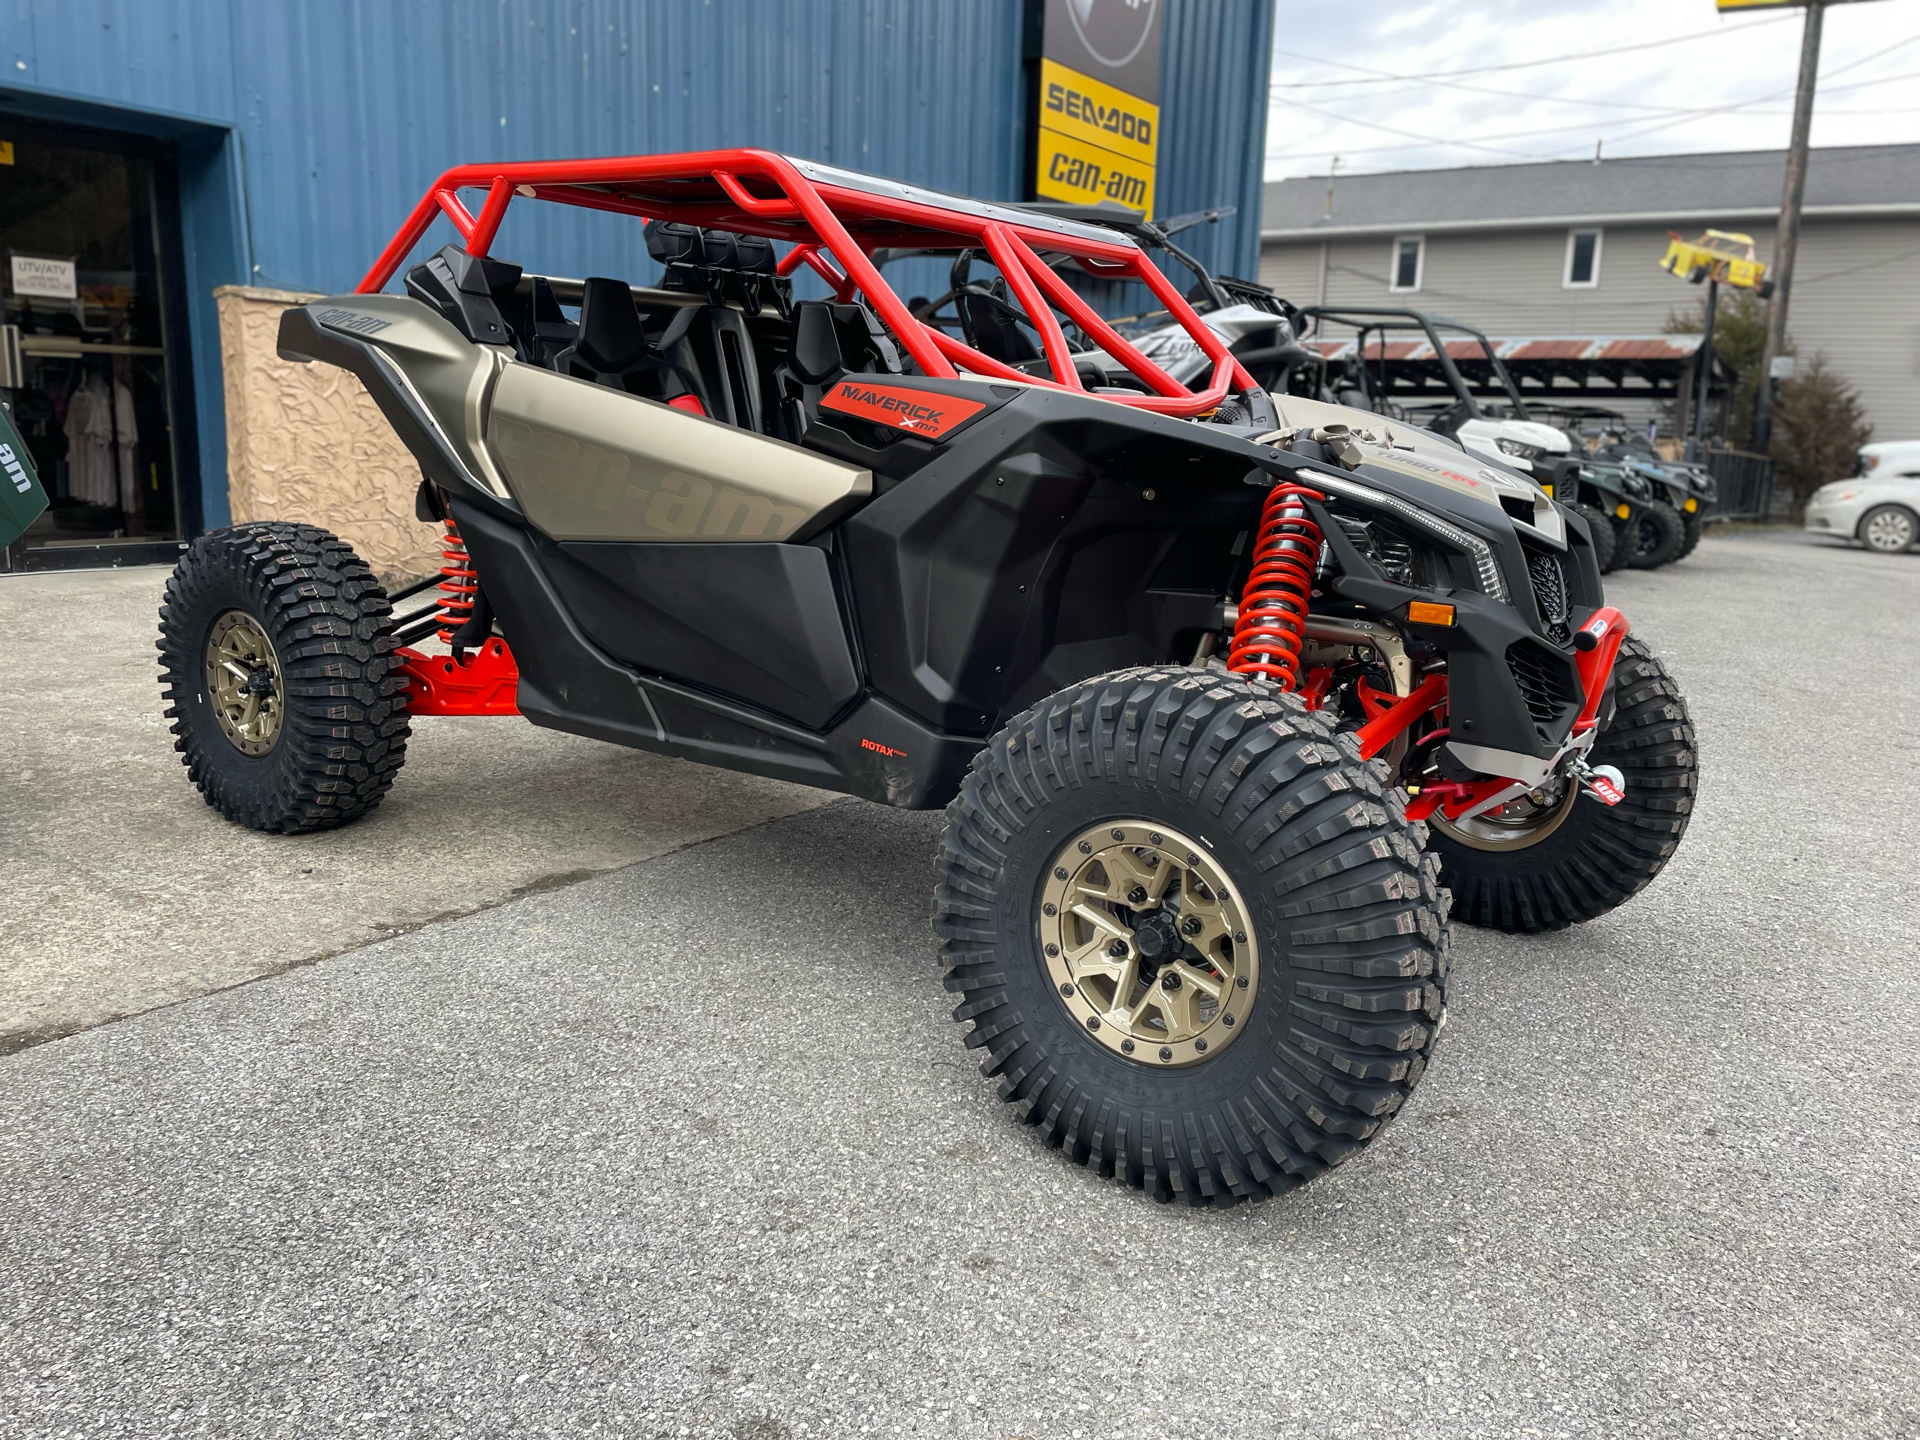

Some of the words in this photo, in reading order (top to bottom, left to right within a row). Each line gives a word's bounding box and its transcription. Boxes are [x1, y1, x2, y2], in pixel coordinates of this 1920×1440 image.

[18, 261, 67, 276] UTV/ATV
[315, 308, 393, 335] can-am
[840, 384, 946, 424] MAVERICK
[1377, 450, 1440, 473] TURBO
[1440, 471, 1480, 488] RR
[861, 738, 894, 757] ROTAX
